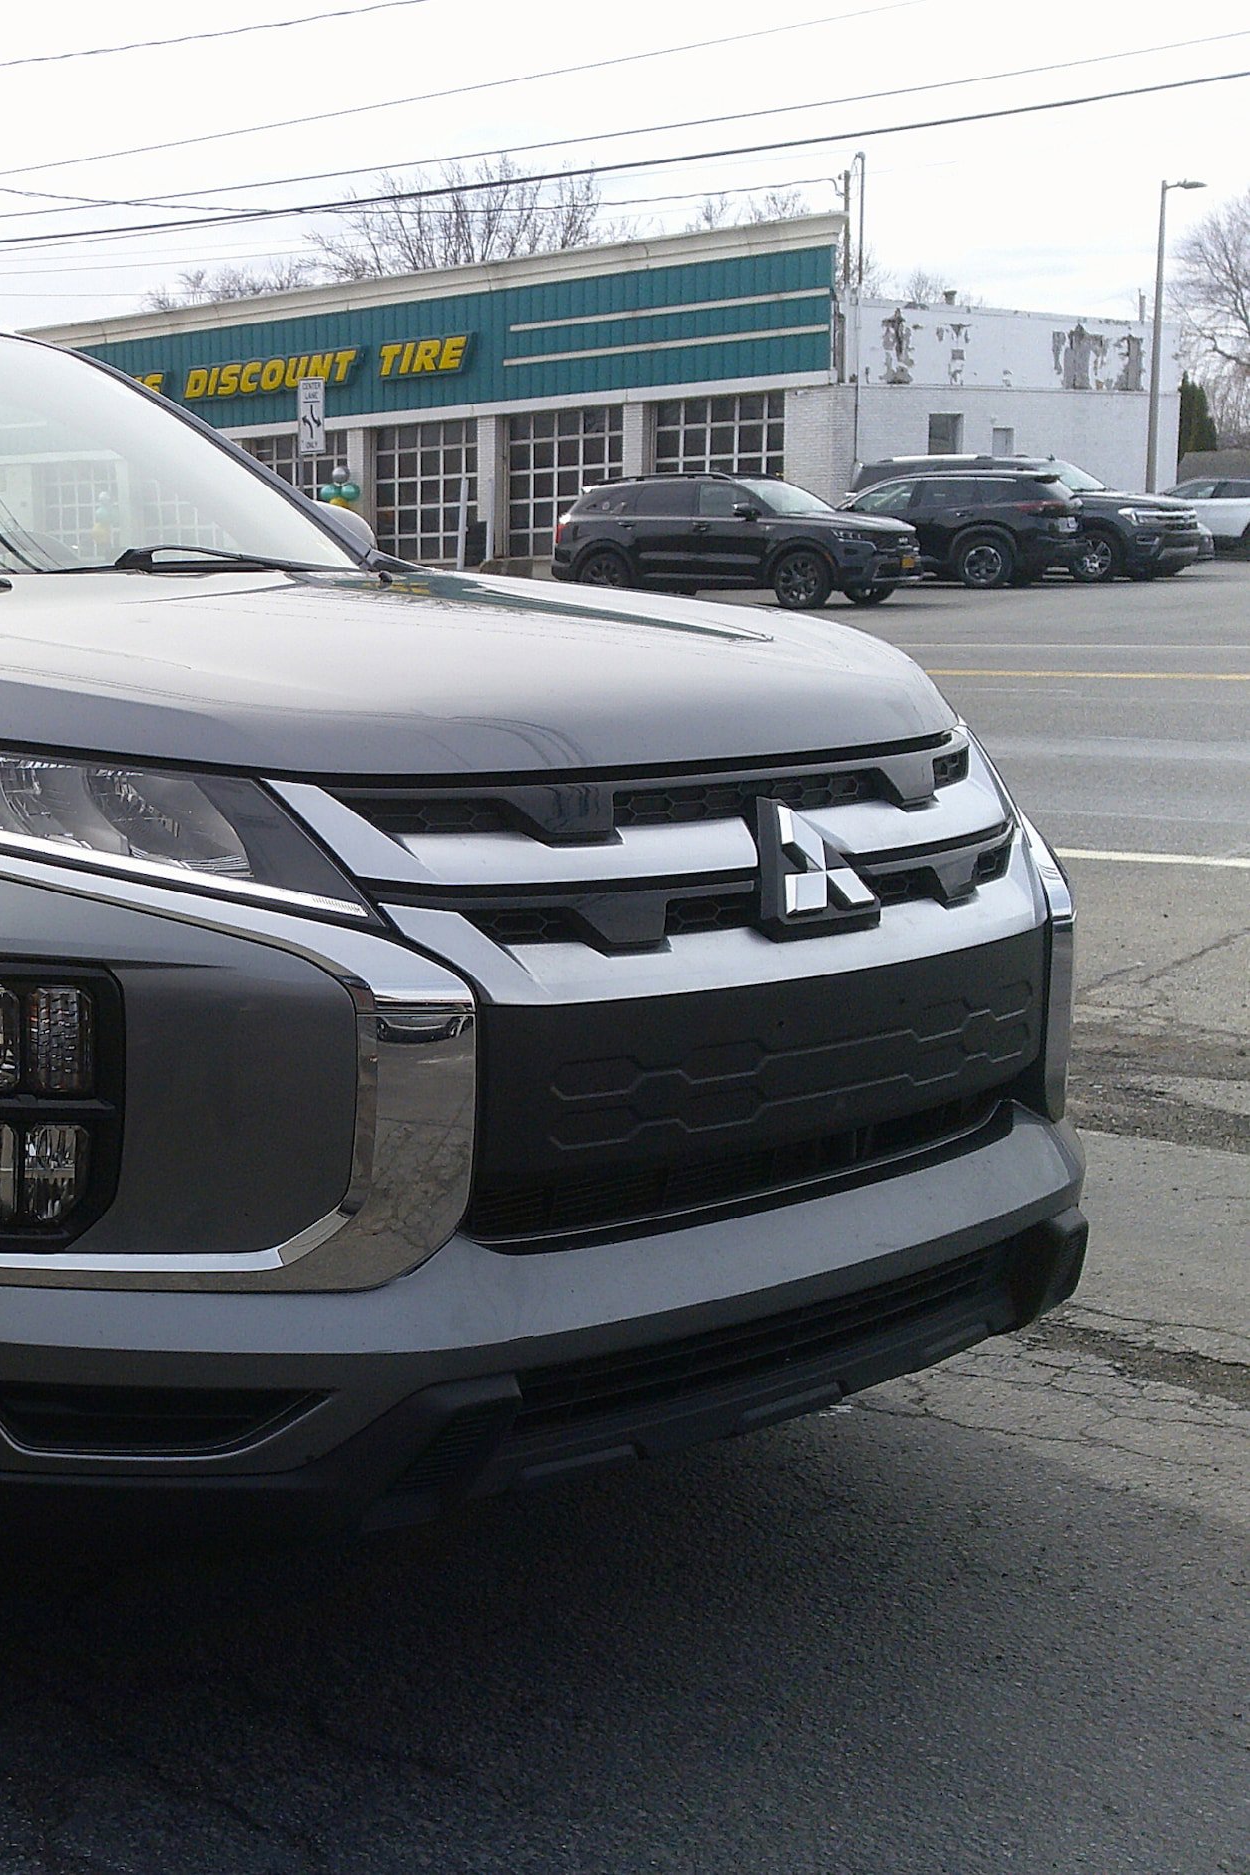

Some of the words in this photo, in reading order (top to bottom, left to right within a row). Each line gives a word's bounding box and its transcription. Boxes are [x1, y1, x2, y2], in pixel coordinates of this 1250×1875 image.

[184, 350, 357, 398] DISCOUNT
[380, 336, 467, 376] TIRE
[302, 382, 321, 390] CENTER
[304, 392, 318, 400] LANE
